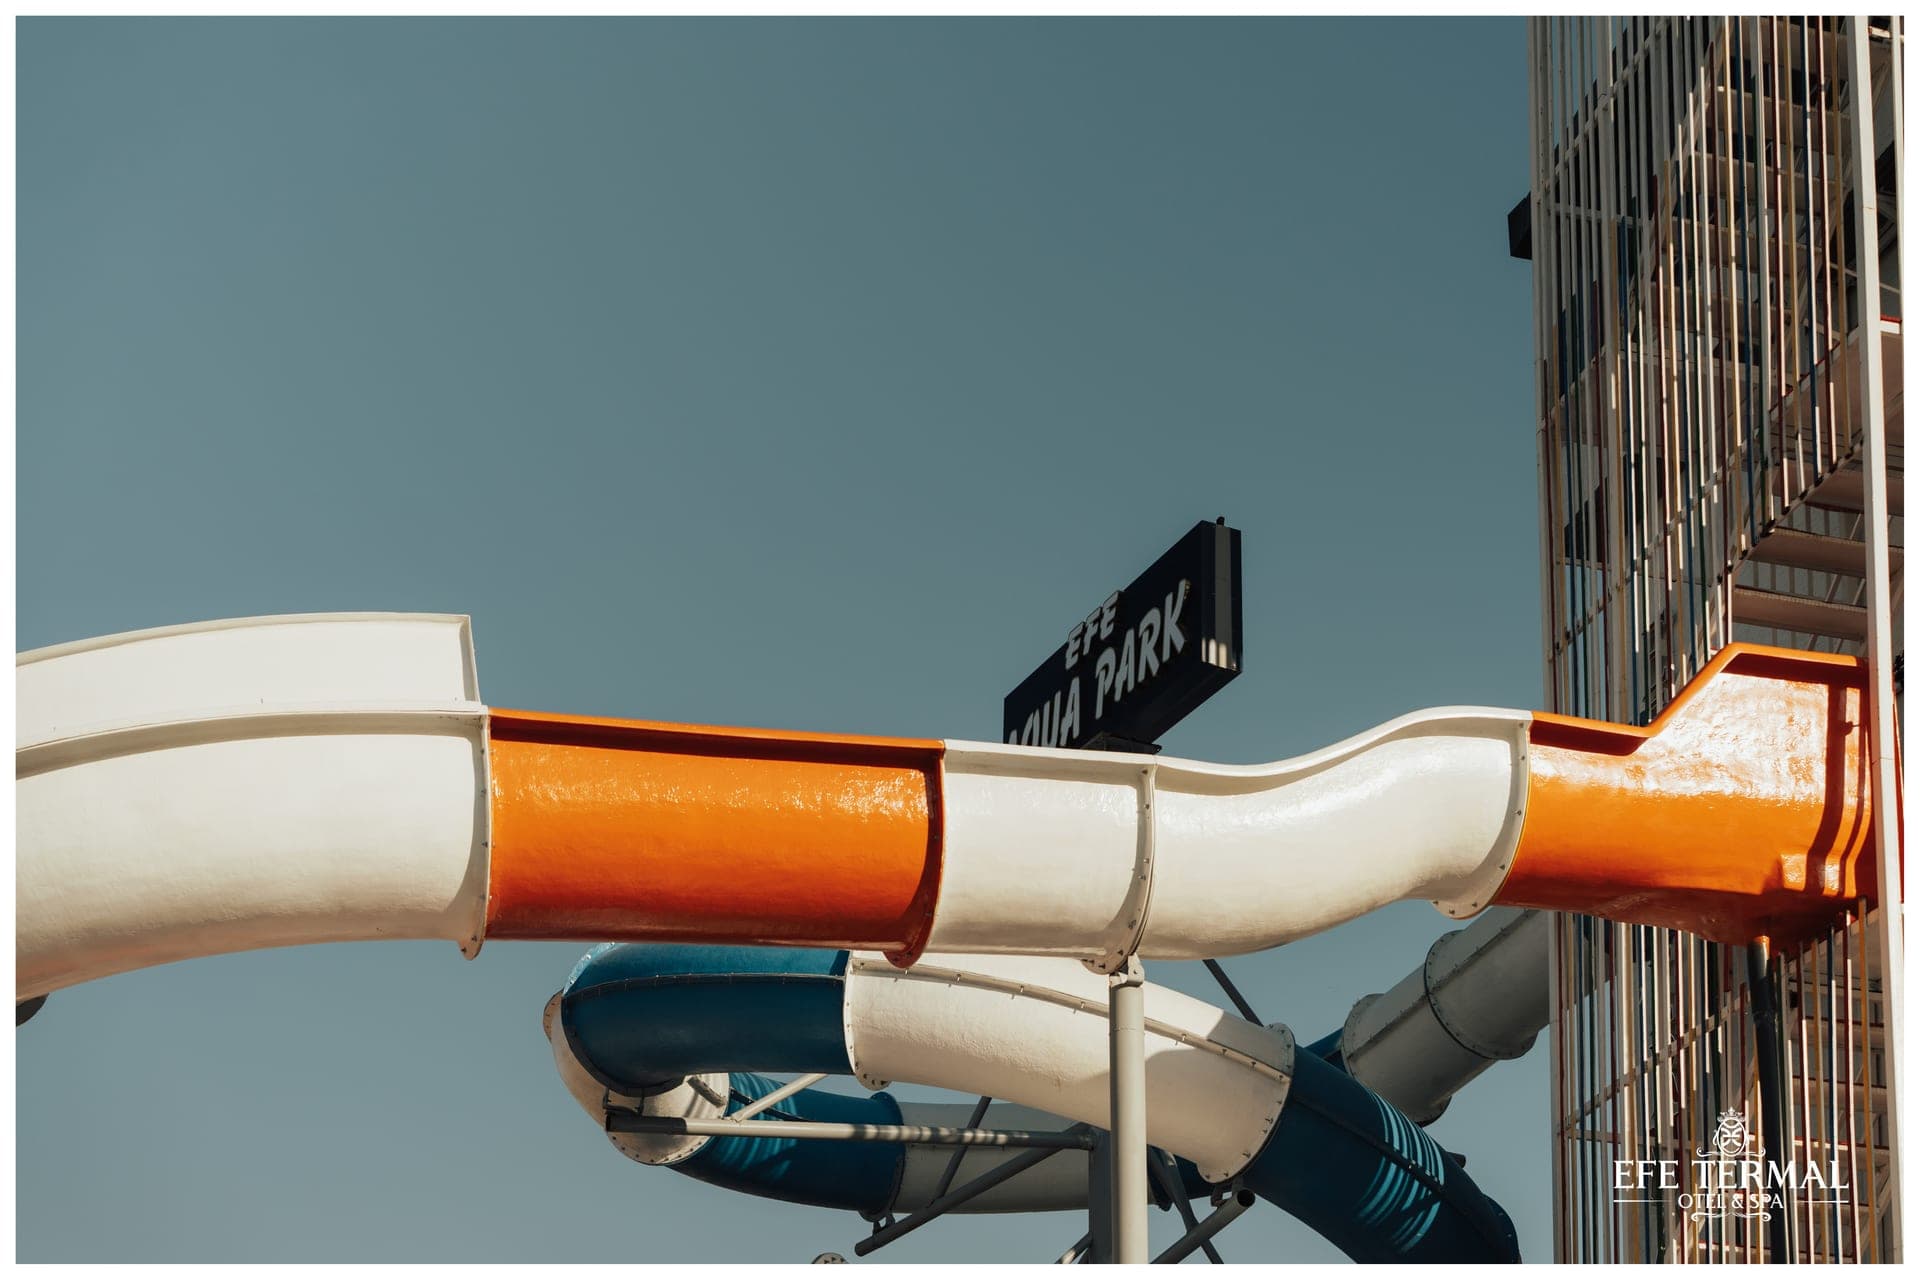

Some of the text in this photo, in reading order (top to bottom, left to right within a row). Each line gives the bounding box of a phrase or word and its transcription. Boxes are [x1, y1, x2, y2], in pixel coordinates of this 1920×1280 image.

[1009, 579, 1188, 748] QUA PARK
[1065, 590, 1121, 670] EFE
